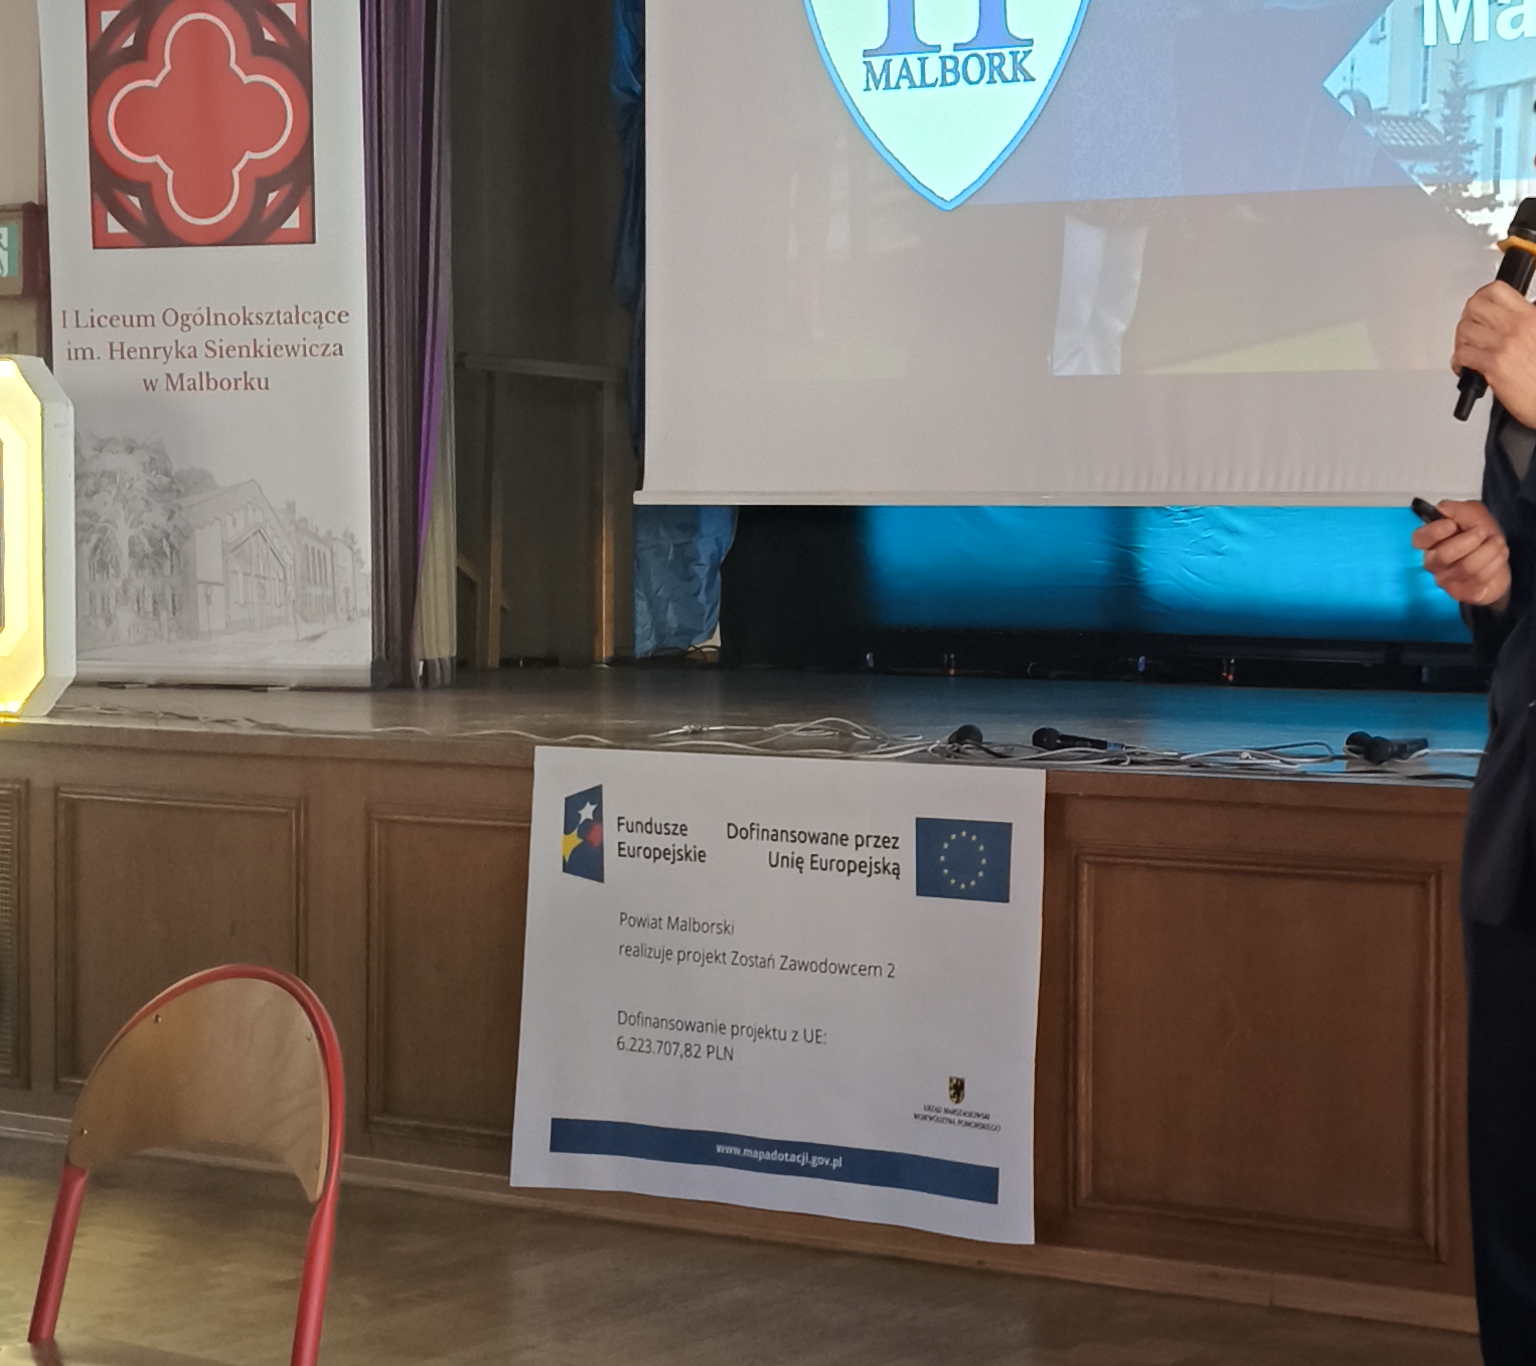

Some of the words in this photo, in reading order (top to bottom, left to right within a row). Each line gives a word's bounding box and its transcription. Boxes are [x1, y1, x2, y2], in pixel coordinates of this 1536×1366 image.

[863, 49, 1036, 92] MALBORK
[61, 310, 68, 329] I
[74, 308, 155, 328] Liceum
[162, 305, 350, 332] Ogólnokształcące
[67, 342, 101, 360] im.
[108, 339, 198, 364] Henryka
[204, 337, 344, 360] Sienkiewicza
[142, 377, 159, 392] w
[165, 371, 270, 392] Malborku
[617, 816, 689, 836] Fundusze
[727, 822, 849, 847] Dofinansowane
[854, 833, 900, 850] przez
[617, 842, 707, 865] Europejskie
[768, 851, 805, 874] Unię
[810, 854, 901, 881] Europejską
[619, 912, 663, 930] Powiat
[666, 915, 735, 935] Malborski
[619, 942, 673, 963] realizuje
[676, 948, 727, 968] projekt
[731, 950, 775, 969] Zostań
[779, 955, 883, 977] Zawodowcem
[887, 963, 896, 978] 2
[617, 1010, 726, 1035] Dofinansowanie
[731, 1023, 787, 1043] projektu
[791, 1030, 799, 1042] z
[803, 1028, 827, 1045] UE:
[616, 1036, 702, 1060] 6.223.707,82
[706, 1044, 734, 1061] PLN
[716, 1144, 843, 1170] www.mapadotacji.gov.pl
